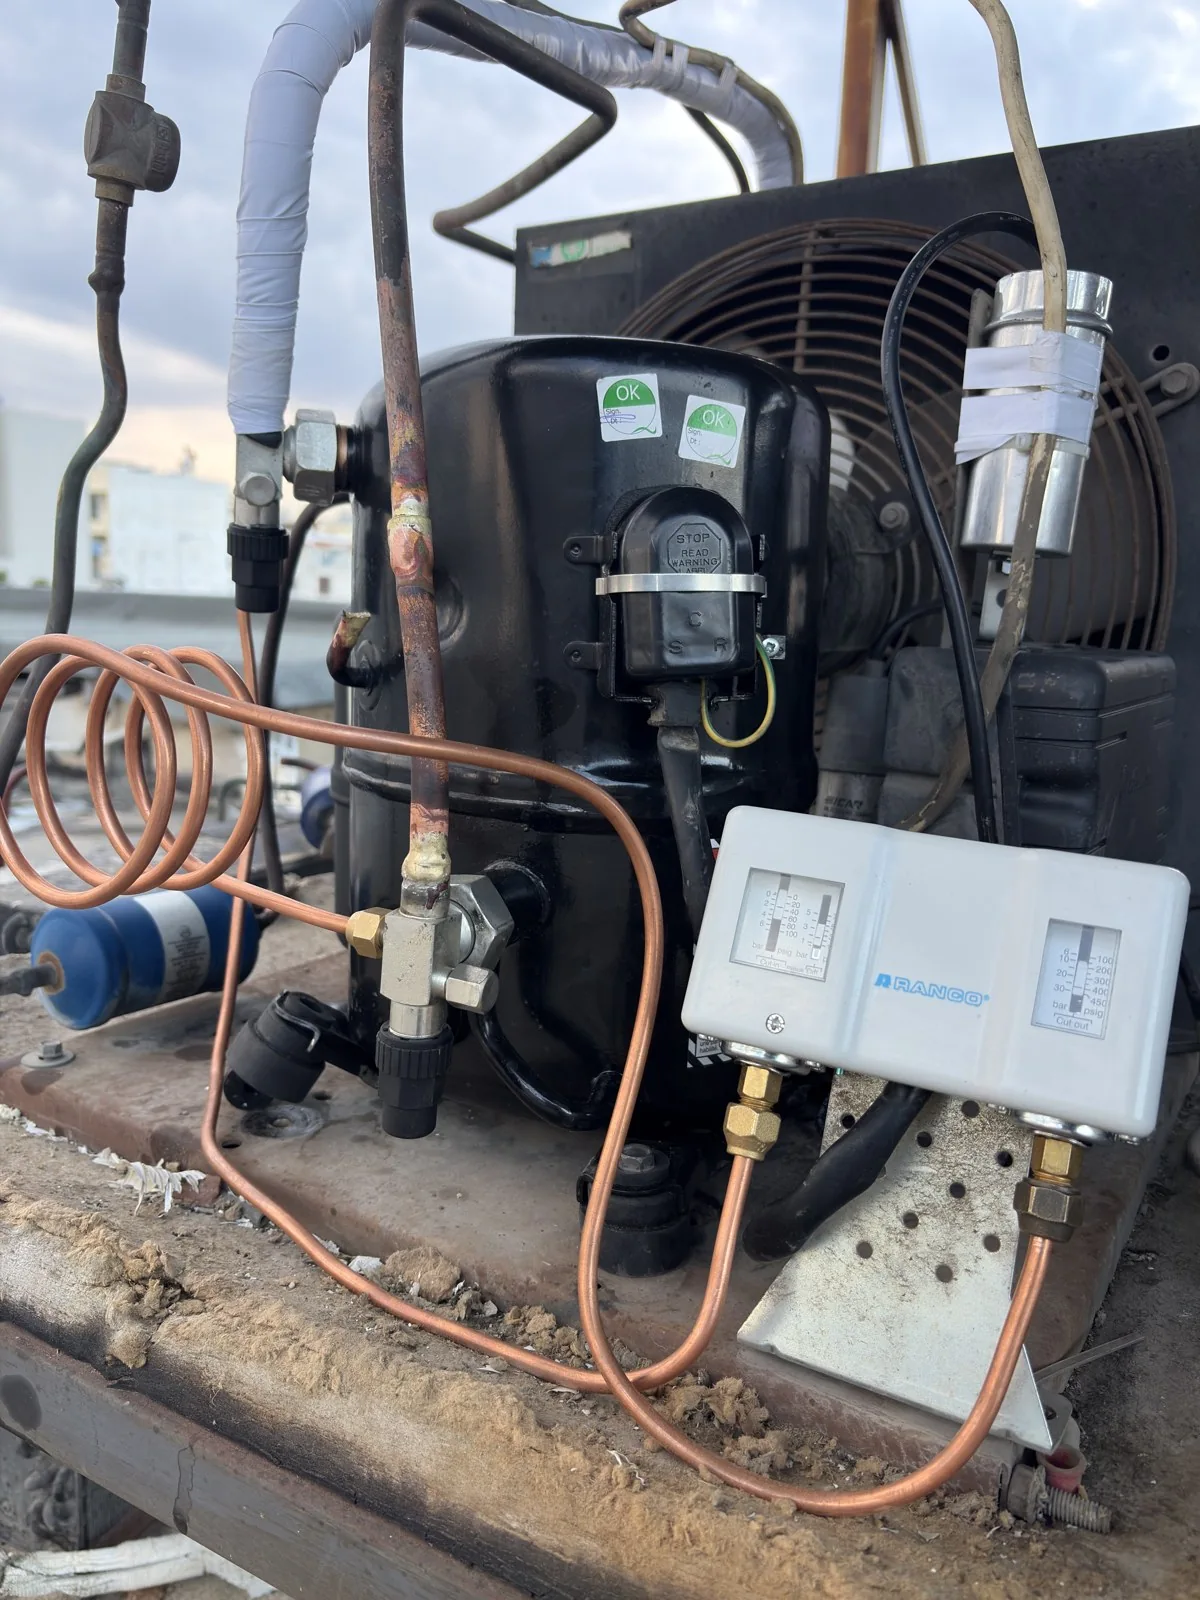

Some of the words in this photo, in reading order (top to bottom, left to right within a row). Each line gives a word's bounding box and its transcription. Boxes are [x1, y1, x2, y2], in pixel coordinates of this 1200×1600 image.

[616, 384, 641, 401] OK
[702, 409, 726, 428] OK
[676, 533, 710, 544] STOP
[681, 548, 709, 557] READ
[671, 557, 718, 567] WARNING
[688, 611, 702, 627] C
[668, 640, 683, 654] S
[713, 637, 728, 652] R
[791, 901, 800, 909] 20
[790, 908, 799, 916] 40
[806, 908, 811, 916] 5
[785, 930, 798, 938] 100
[1060, 954, 1070, 963] 10
[1097, 955, 1113, 964] 100
[1056, 968, 1067, 977] 20
[1053, 984, 1065, 992] 30
[1052, 1000, 1067, 1010] bar
[1084, 1007, 1104, 1019] psig
[1056, 1016, 1072, 1027] Cut
[1073, 1021, 1089, 1031] out
